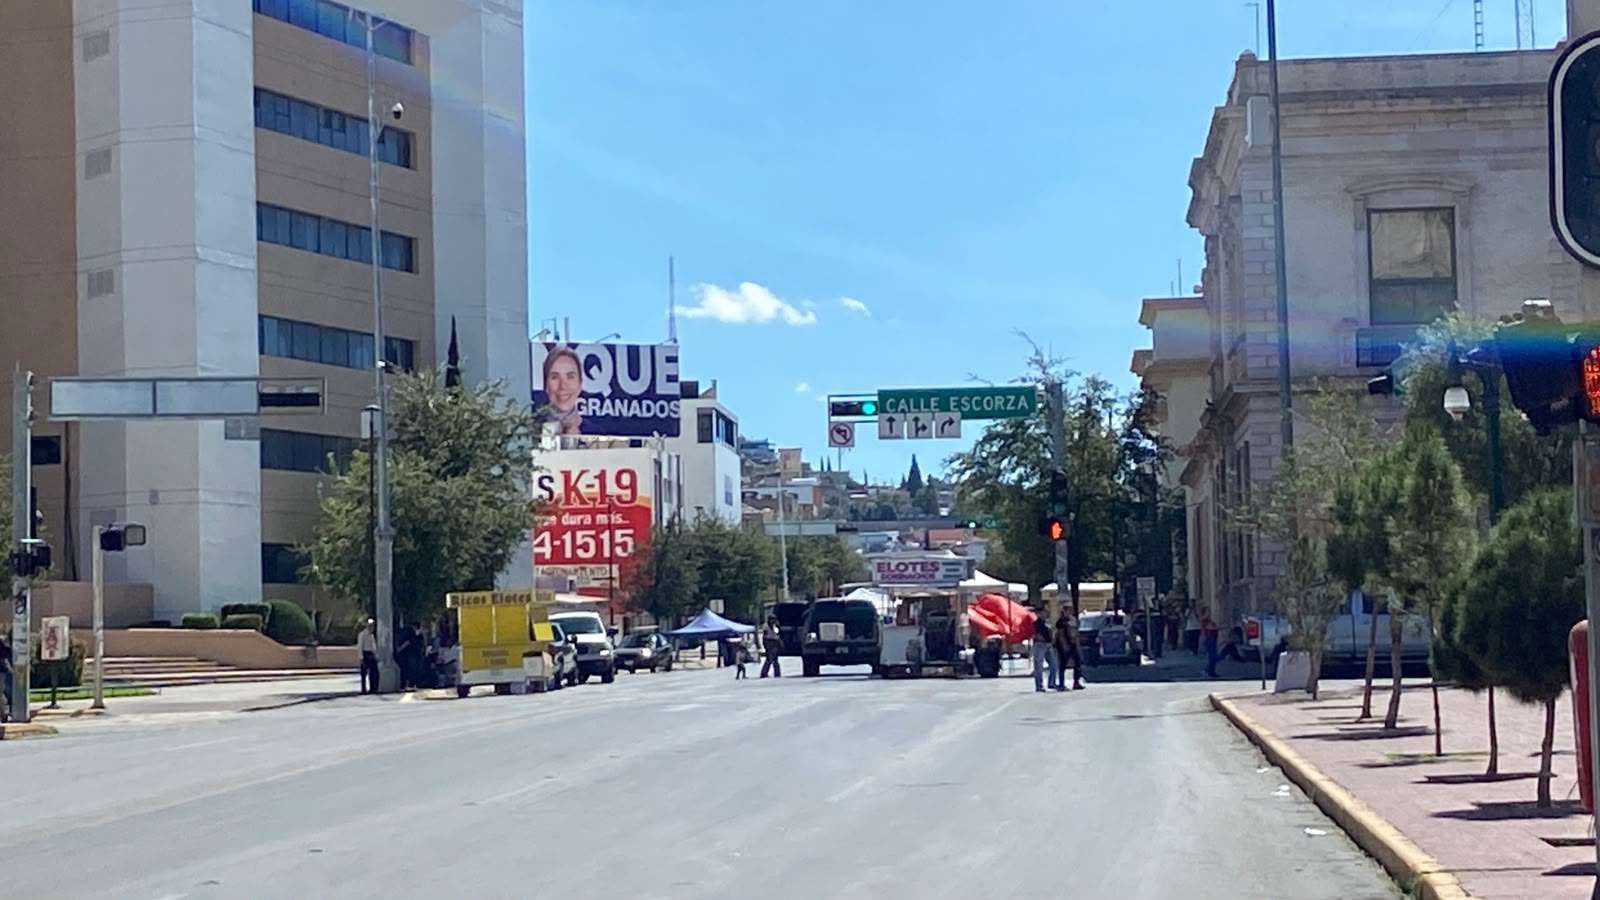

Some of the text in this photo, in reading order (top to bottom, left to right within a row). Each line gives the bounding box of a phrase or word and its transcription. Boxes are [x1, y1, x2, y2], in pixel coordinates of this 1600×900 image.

[576, 398, 680, 418] GRANADOS
[886, 395, 1029, 412] CALLE ESCORZA
[560, 468, 638, 506] K-19
[533, 528, 634, 560] 4-1515
[876, 561, 940, 573] ELOTES
